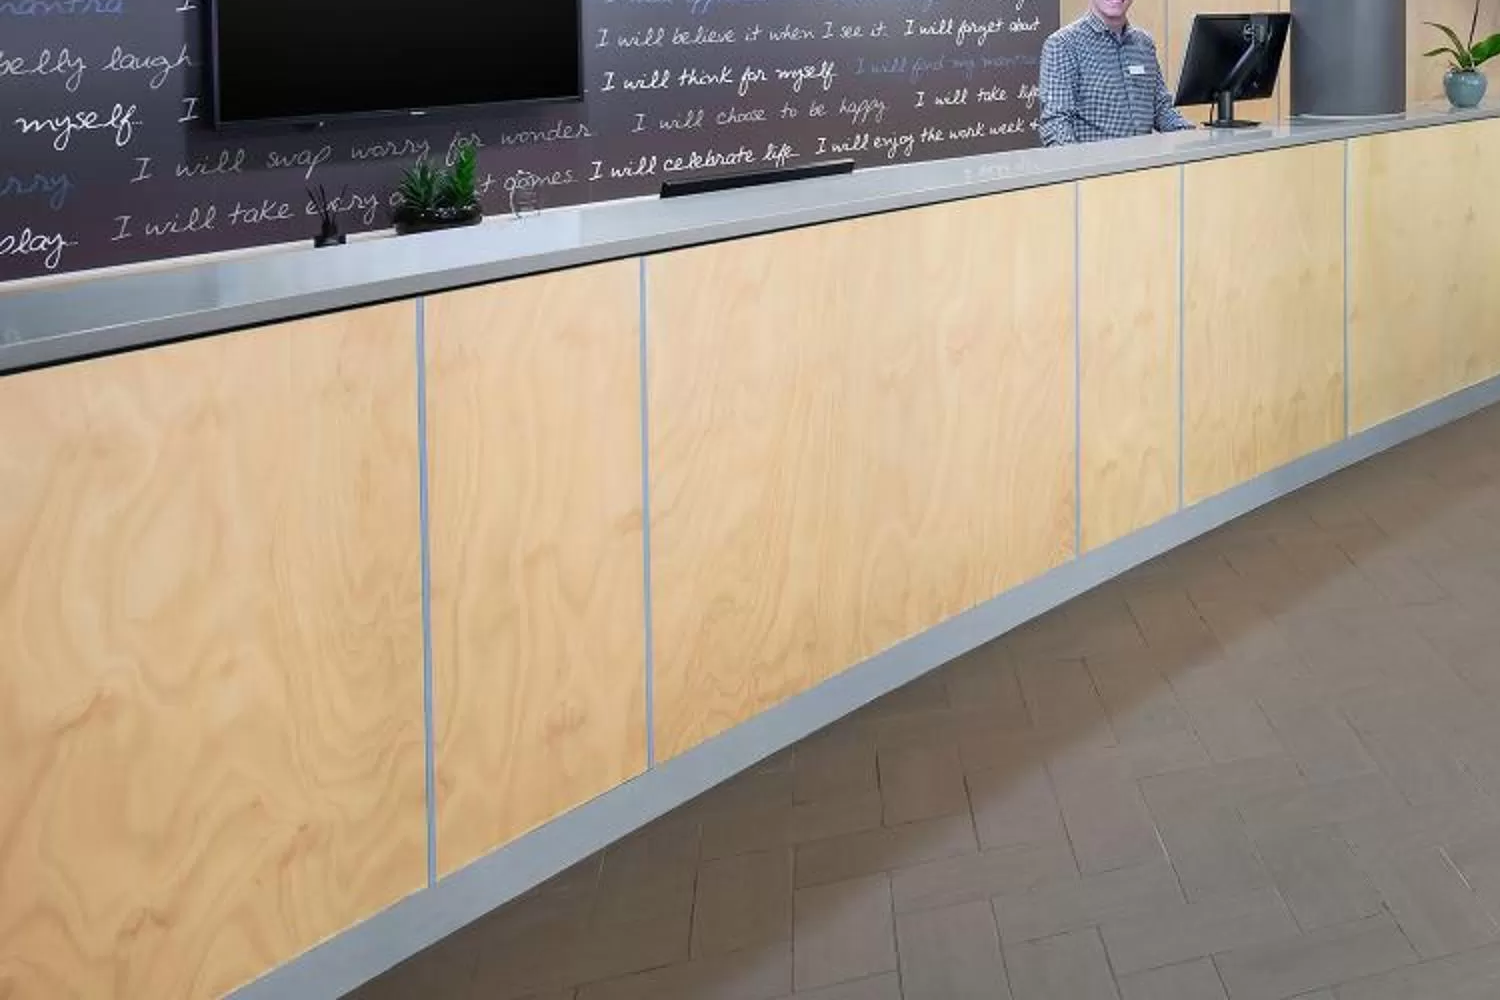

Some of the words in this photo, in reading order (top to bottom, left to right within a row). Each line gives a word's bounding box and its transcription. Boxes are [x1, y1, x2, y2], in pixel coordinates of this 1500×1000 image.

[594, 27, 610, 50] I
[616, 25, 666, 49] will
[671, 25, 738, 47] believe
[743, 24, 764, 43] it
[768, 22, 816, 43] when
[820, 19, 834, 40] I
[838, 24, 864, 40] see
[902, 17, 915, 37] I
[918, 17, 954, 37] will
[954, 16, 1005, 48] forget
[1007, 15, 1042, 34] about
[100, 43, 195, 90] laugh
[599, 70, 617, 93] I
[622, 66, 671, 91] will
[677, 64, 735, 88] think
[736, 64, 769, 98] for
[774, 59, 838, 94] myself
[177, 96, 201, 124] I
[129, 156, 153, 185] I
[174, 147, 246, 179] will
[265, 144, 333, 181] swap
[350, 136, 431, 168] worry
[500, 118, 593, 147] wonder
[629, 112, 647, 134] I
[658, 107, 706, 131] will
[715, 104, 769, 126] choose
[779, 101, 798, 119] to
[808, 99, 827, 118] be
[838, 97, 887, 125] happy
[913, 90, 925, 109] I
[934, 86, 970, 106] will
[976, 83, 1008, 102] take
[110, 214, 134, 242] I
[144, 204, 217, 237] will
[227, 198, 296, 226] take
[588, 160, 604, 182] I
[610, 155, 658, 178] will
[662, 146, 757, 173] celebrate
[814, 136, 828, 156] I
[830, 132, 870, 153] will
[872, 131, 917, 160] enjoy
[919, 125, 946, 143] the
[947, 121, 986, 141] work
[989, 117, 1026, 136] week
